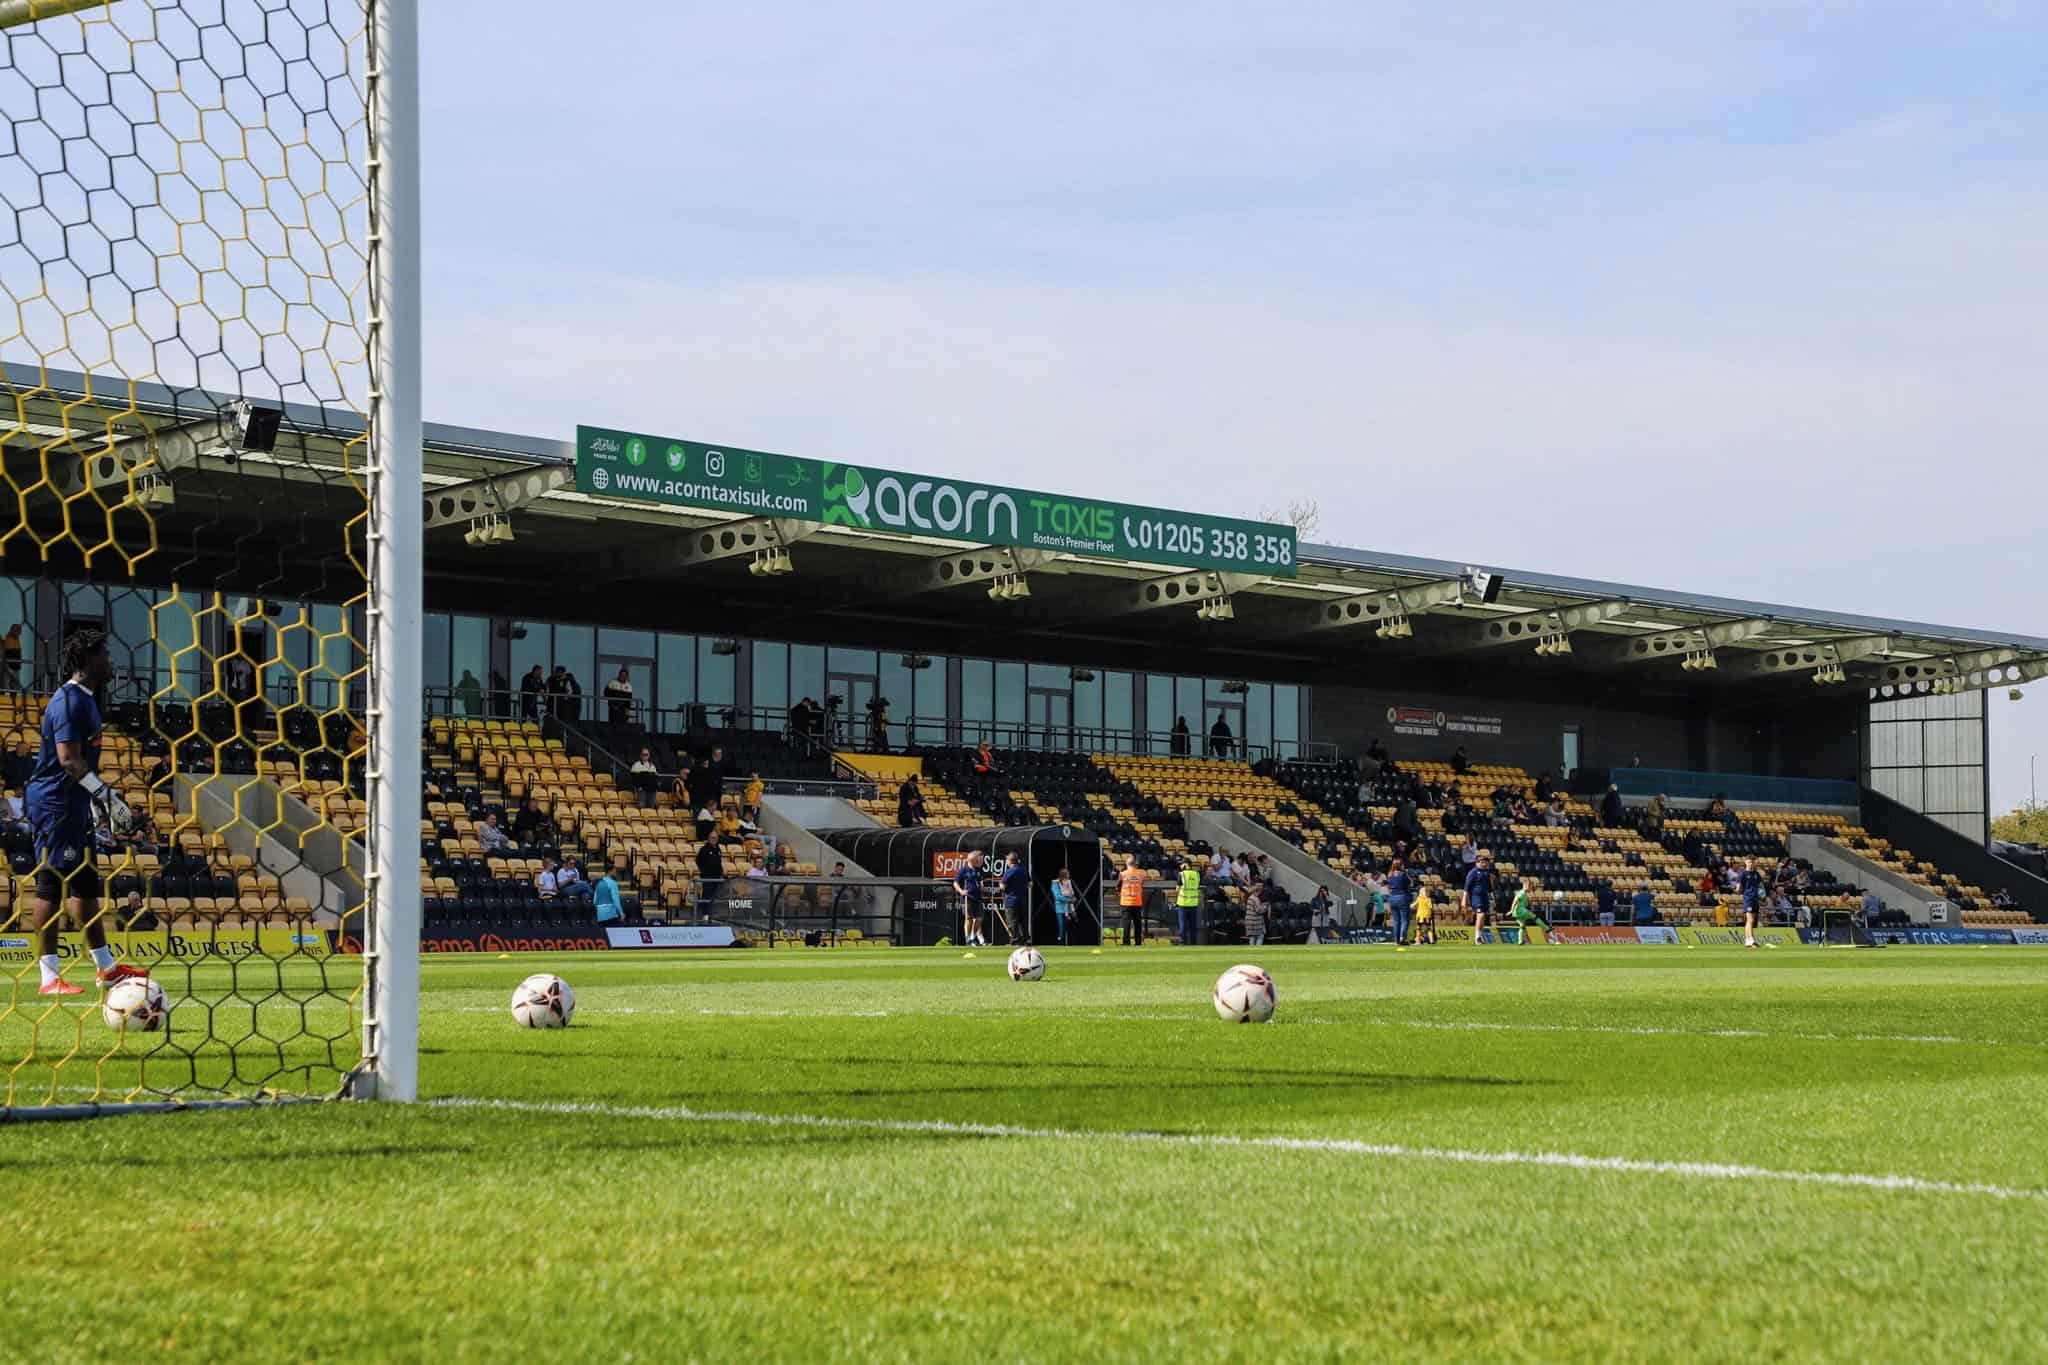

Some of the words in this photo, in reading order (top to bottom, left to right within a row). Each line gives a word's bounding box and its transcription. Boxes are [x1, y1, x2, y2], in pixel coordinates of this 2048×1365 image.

[616, 473, 808, 513] www.acorntaxisuk.com
[875, 477, 1018, 539] acorn
[1033, 532, 1065, 546] Boston's
[1066, 536, 1096, 550] Premier
[1096, 540, 1114, 552] Fleet
[1139, 519, 1204, 554] 01205
[1210, 529, 1248, 560] 358
[1253, 534, 1291, 565] 358
[728, 899, 752, 909] HOME
[56, 937, 162, 958] SHRMAN
[420, 940, 475, 951] rama
